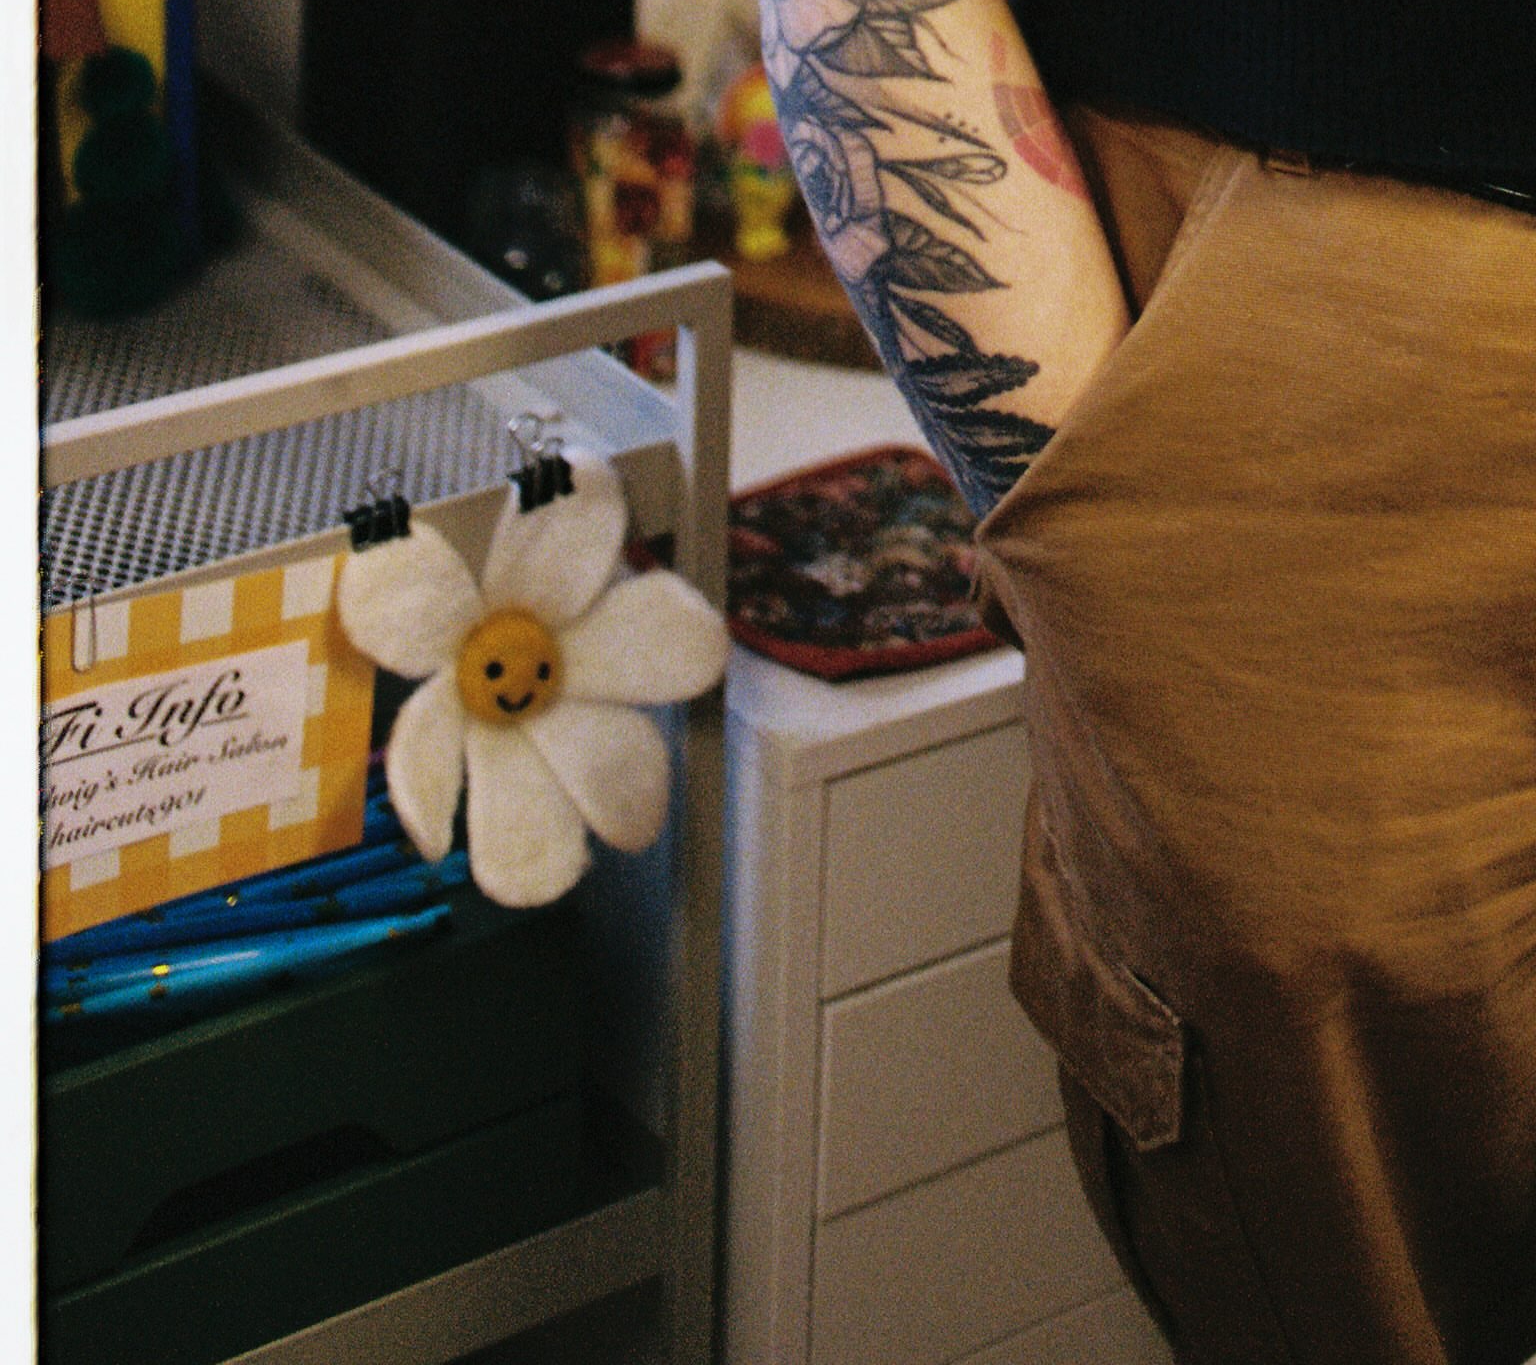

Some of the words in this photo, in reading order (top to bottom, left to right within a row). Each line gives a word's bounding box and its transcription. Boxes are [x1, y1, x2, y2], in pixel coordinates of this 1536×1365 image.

[115, 669, 246, 748] Info
[127, 750, 200, 786] Hair
[206, 731, 289, 763] Salon
